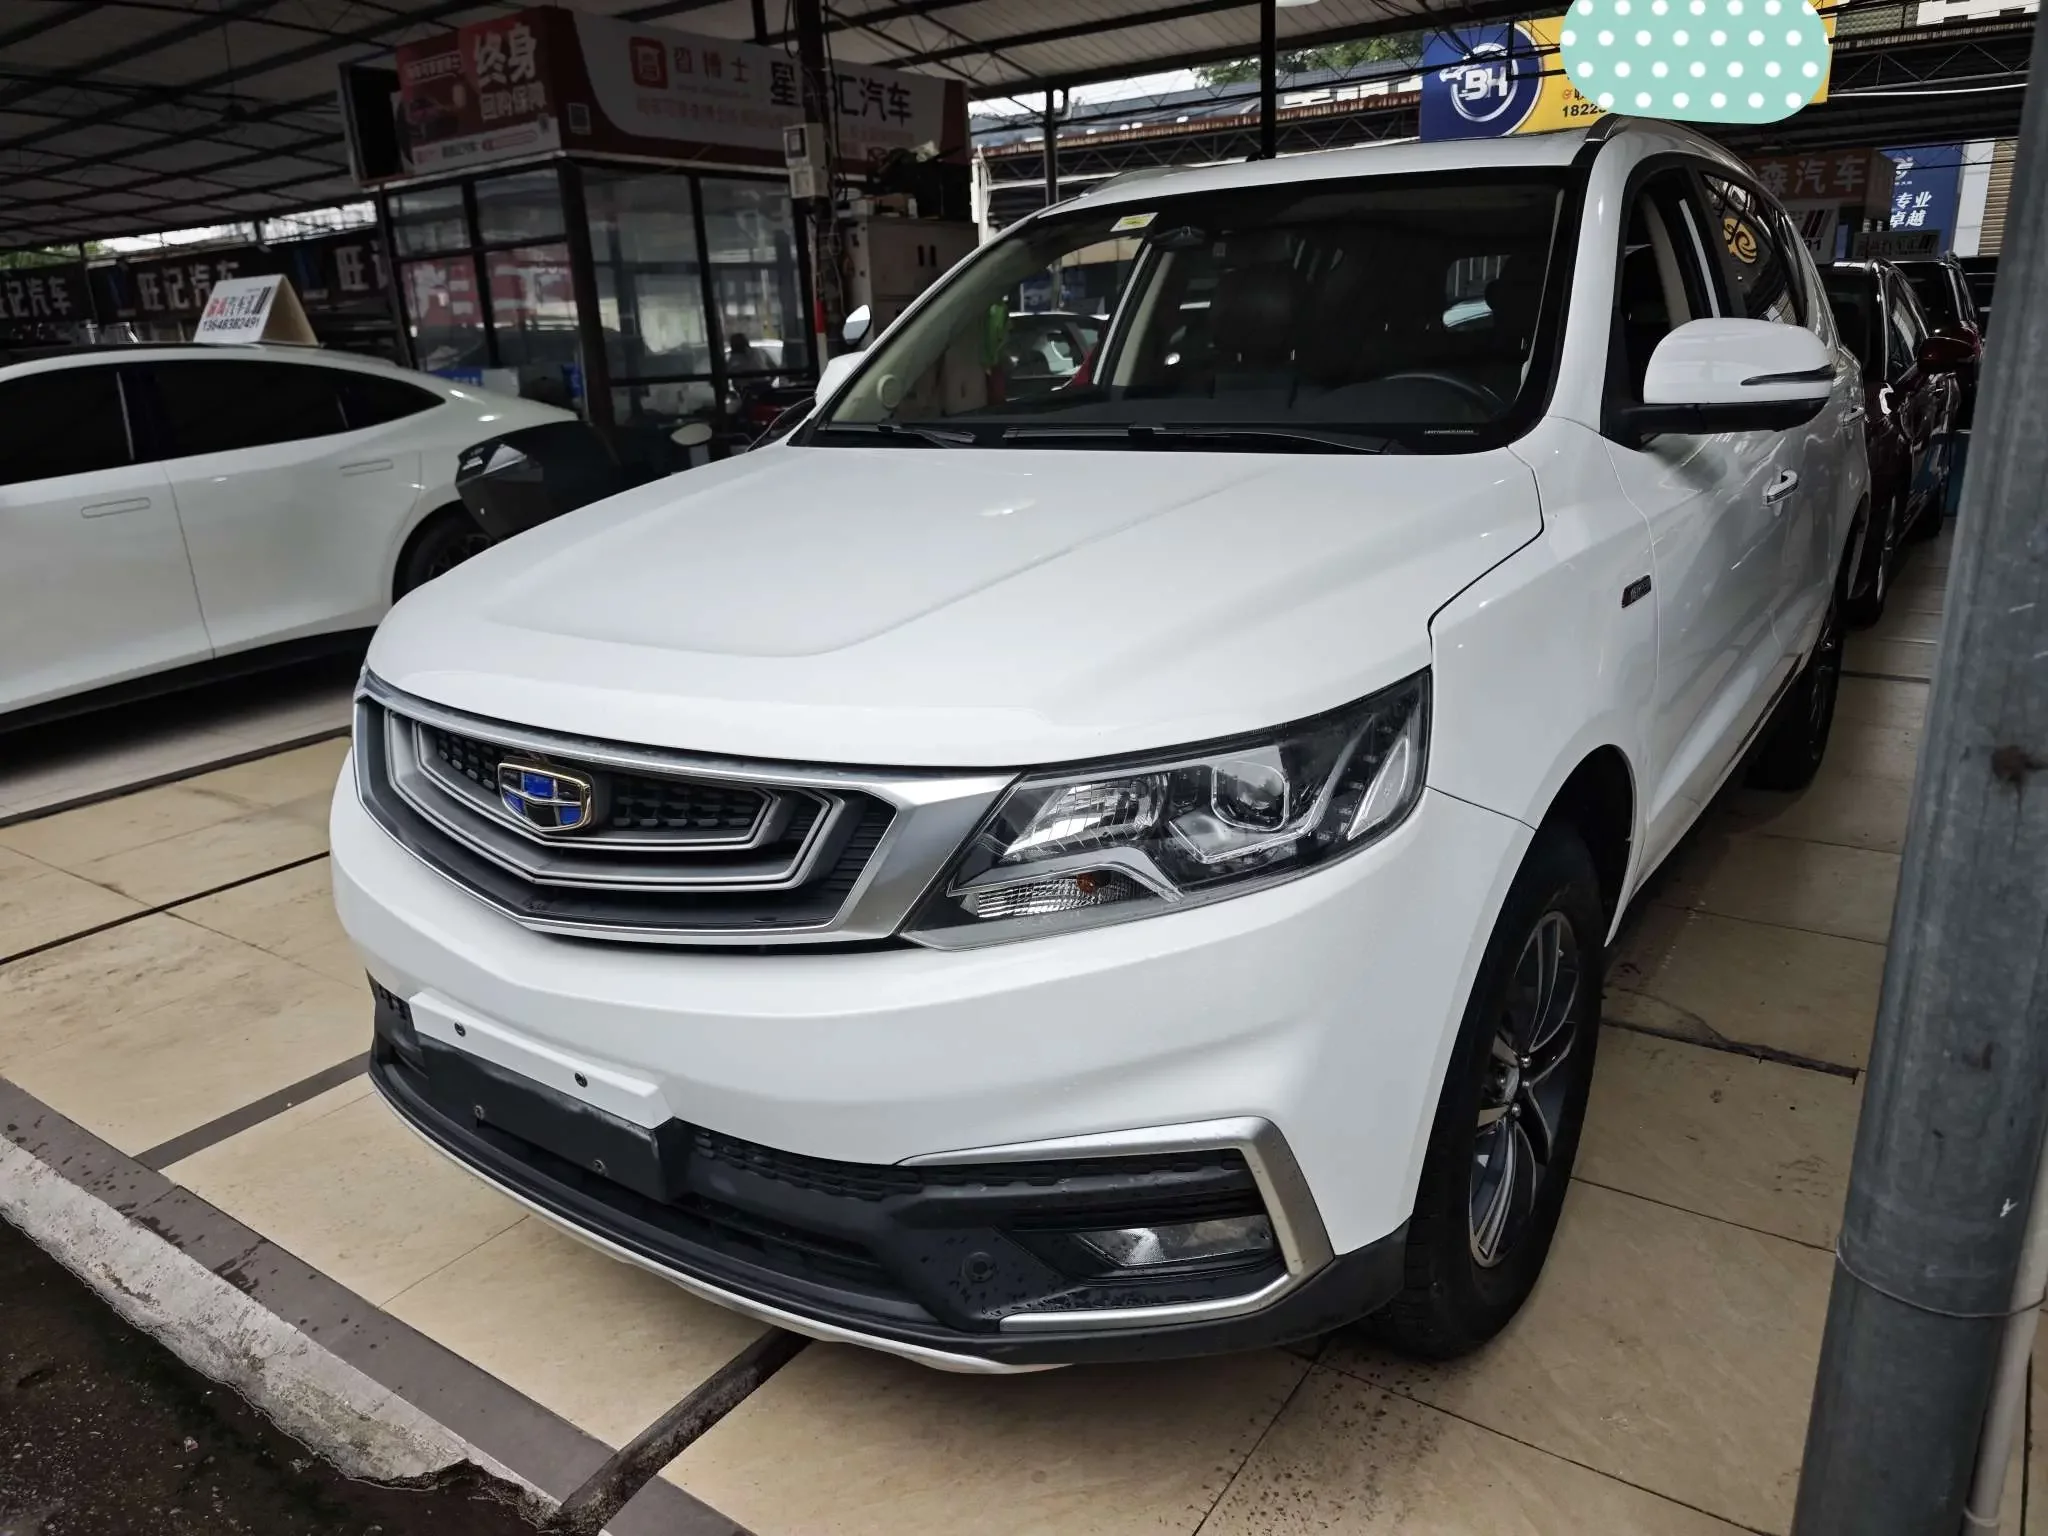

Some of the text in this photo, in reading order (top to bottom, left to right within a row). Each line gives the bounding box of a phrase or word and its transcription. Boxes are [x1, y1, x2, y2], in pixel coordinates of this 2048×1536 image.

[475, 23, 537, 88] 终身
[1896, 191, 1932, 210] 专业
[1890, 209, 1926, 228] 卓越
